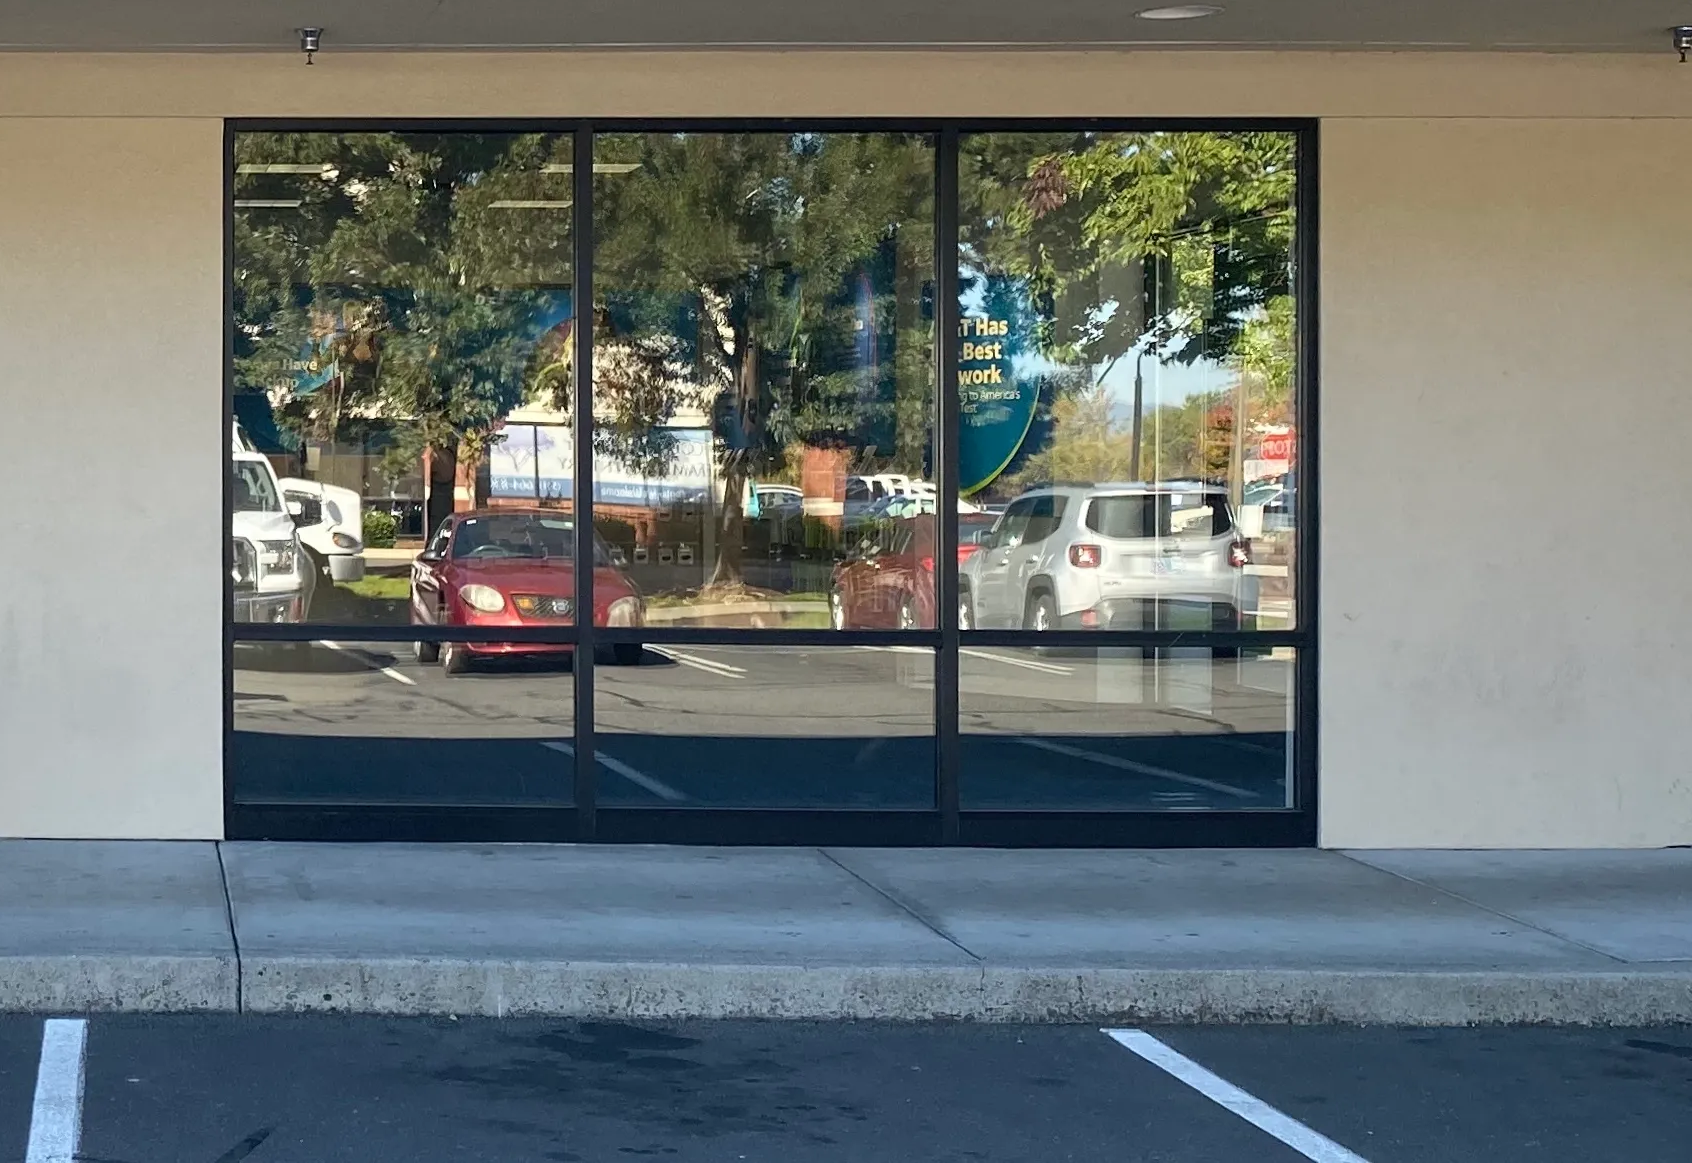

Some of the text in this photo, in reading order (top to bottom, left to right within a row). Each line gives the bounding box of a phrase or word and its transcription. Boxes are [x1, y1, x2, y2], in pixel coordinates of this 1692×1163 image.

[974, 317, 1009, 337] Has
[962, 341, 1002, 361] Best
[282, 358, 318, 372] Have
